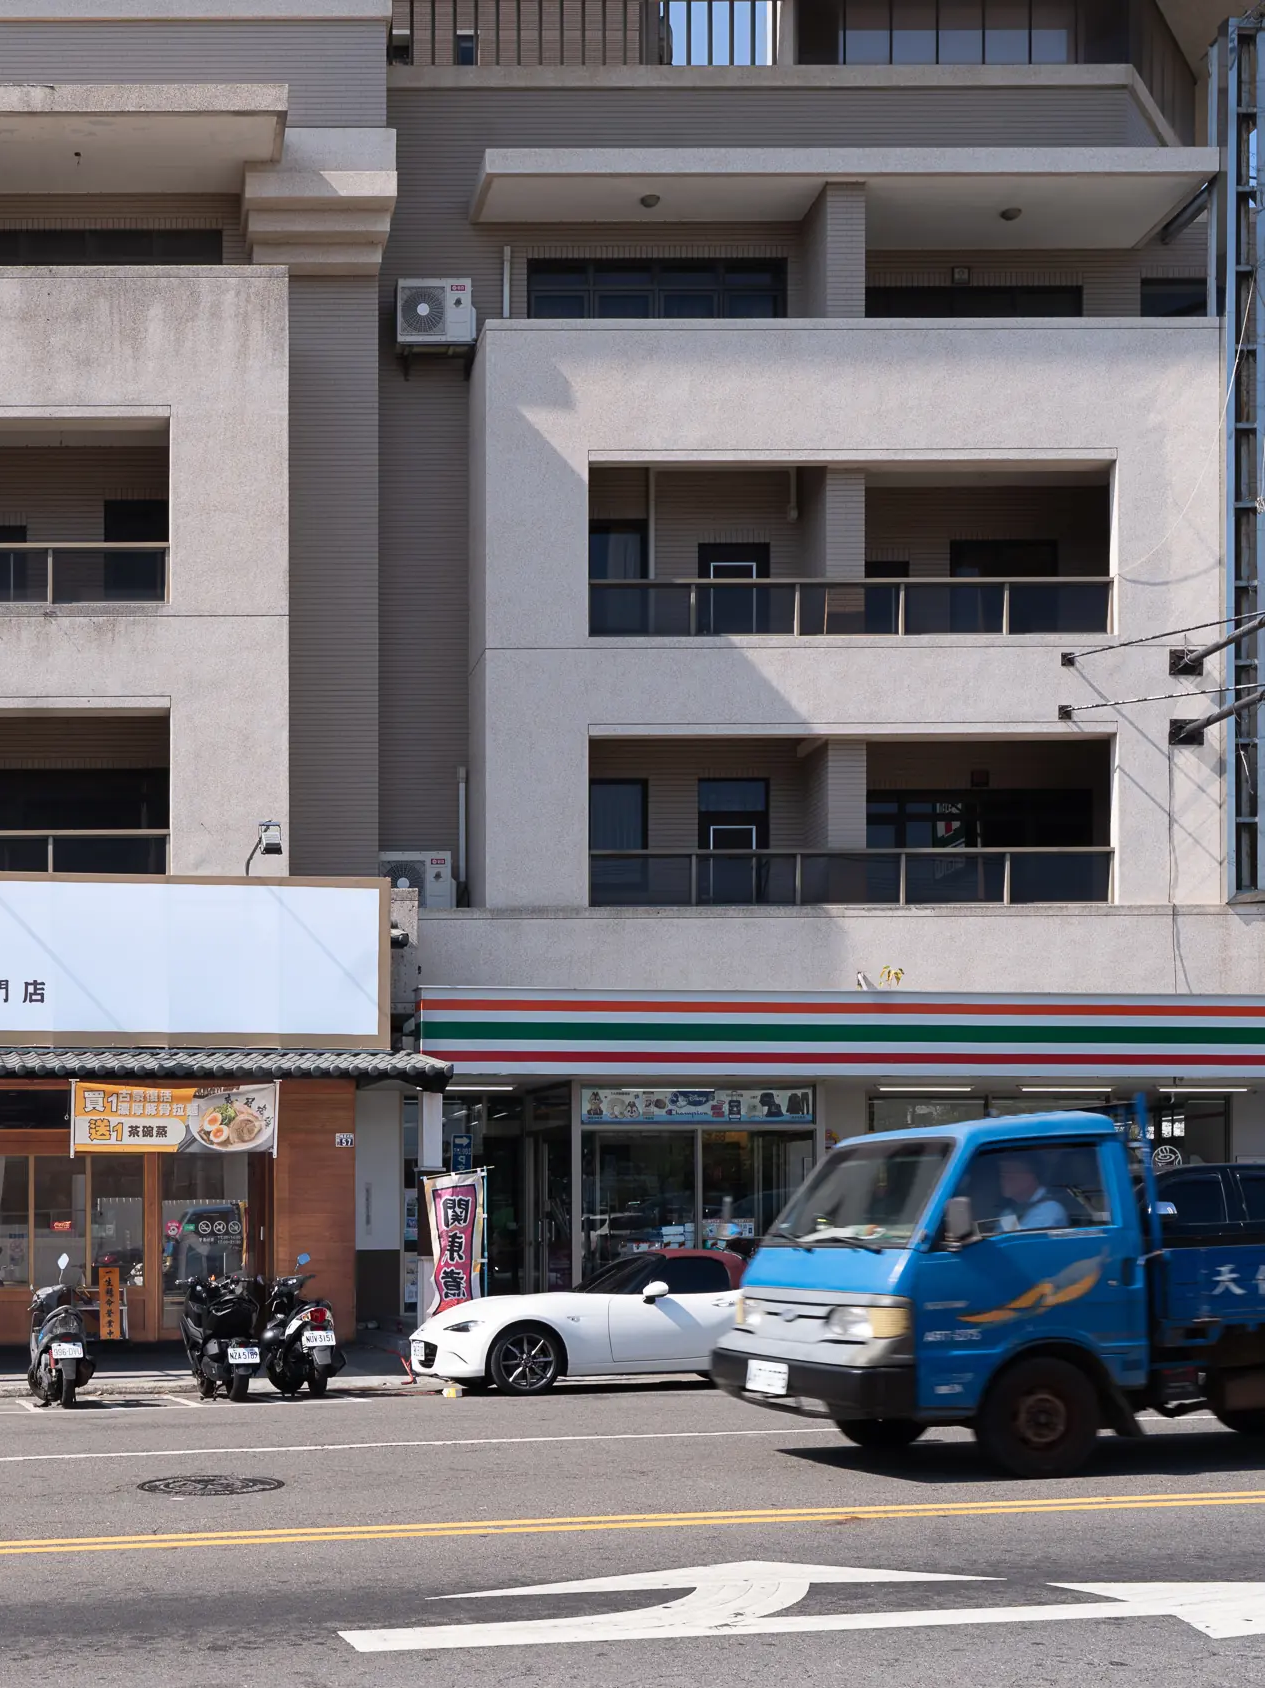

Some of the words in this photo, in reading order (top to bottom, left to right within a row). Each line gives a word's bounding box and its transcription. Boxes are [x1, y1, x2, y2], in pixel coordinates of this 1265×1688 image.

[665, 1108, 709, 1118] Champion
[88, 1118, 124, 1142] 送1
[128, 1125, 168, 1138] 茶碗蒸
[342, 1138, 351, 1146] 57
